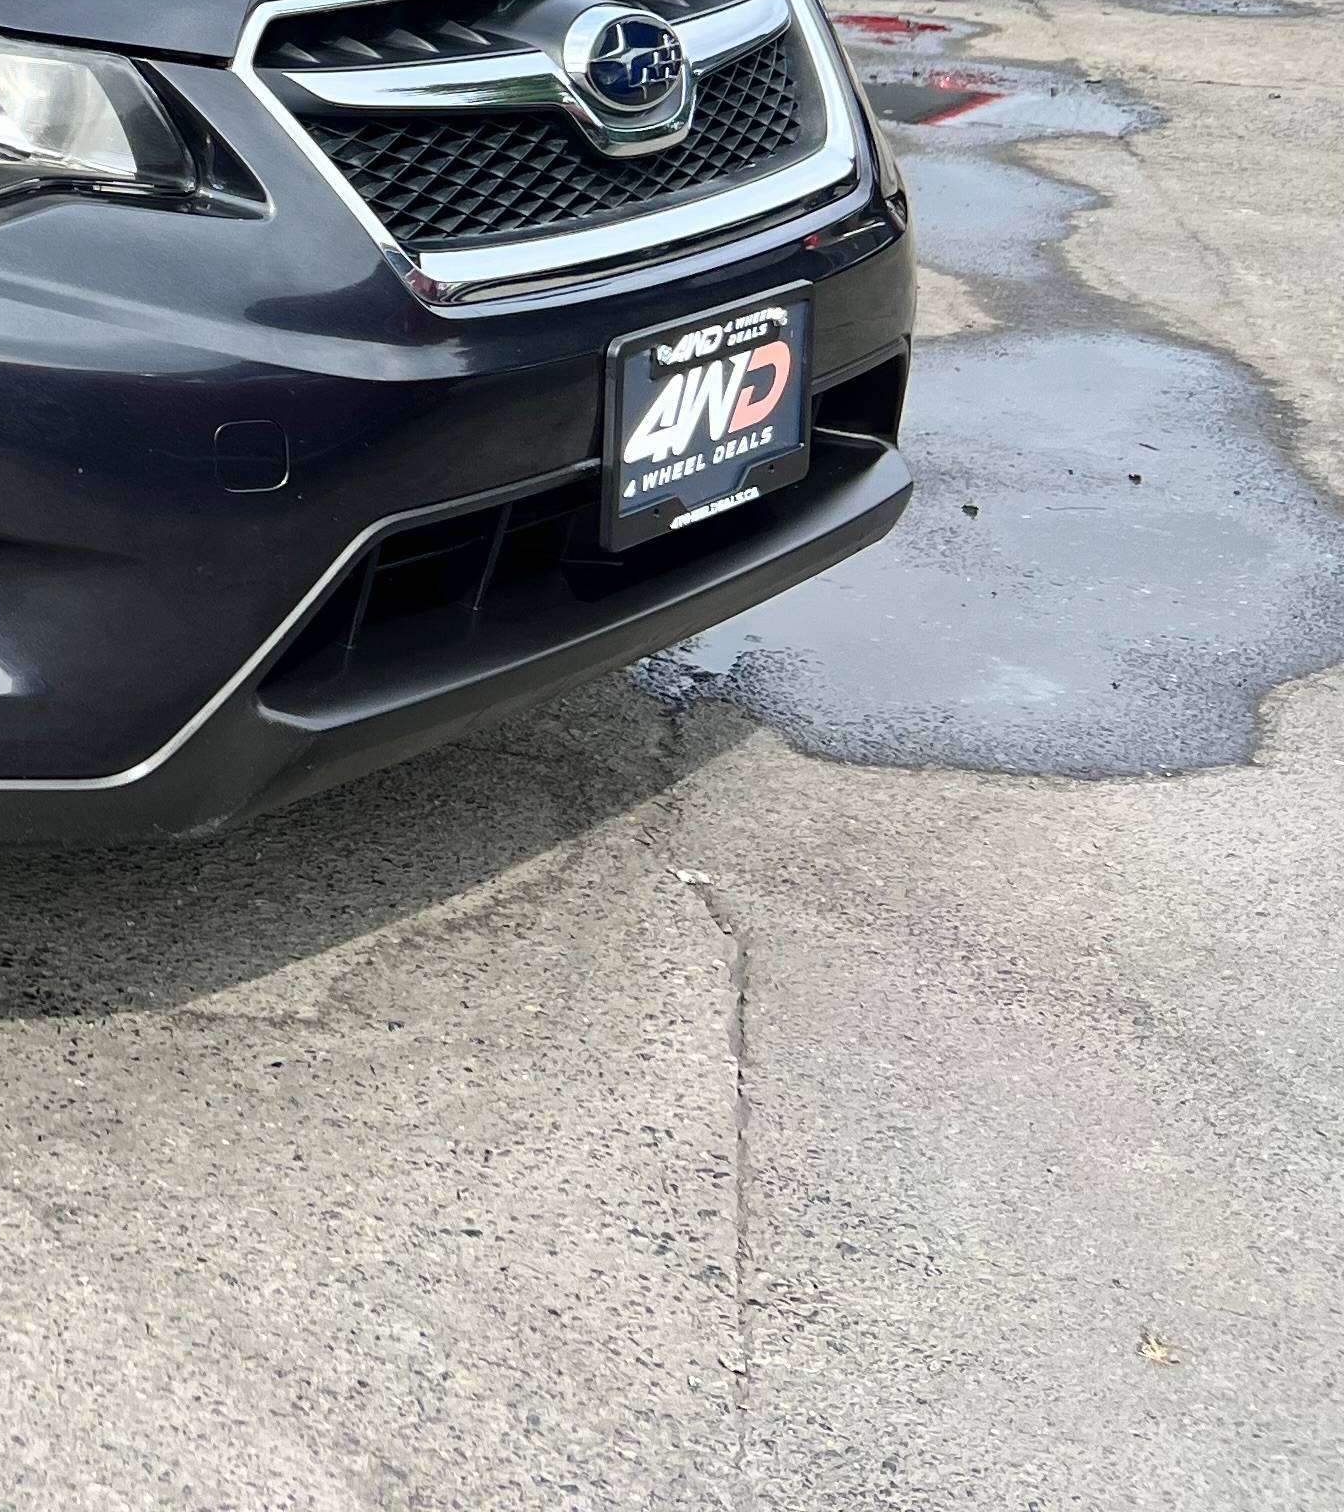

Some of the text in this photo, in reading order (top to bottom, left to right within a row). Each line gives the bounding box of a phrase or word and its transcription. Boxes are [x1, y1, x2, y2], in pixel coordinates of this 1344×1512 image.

[726, 323, 768, 347] DEALS
[623, 340, 791, 464] 4WD
[623, 425, 774, 498] 4 WHEEL DEALS
